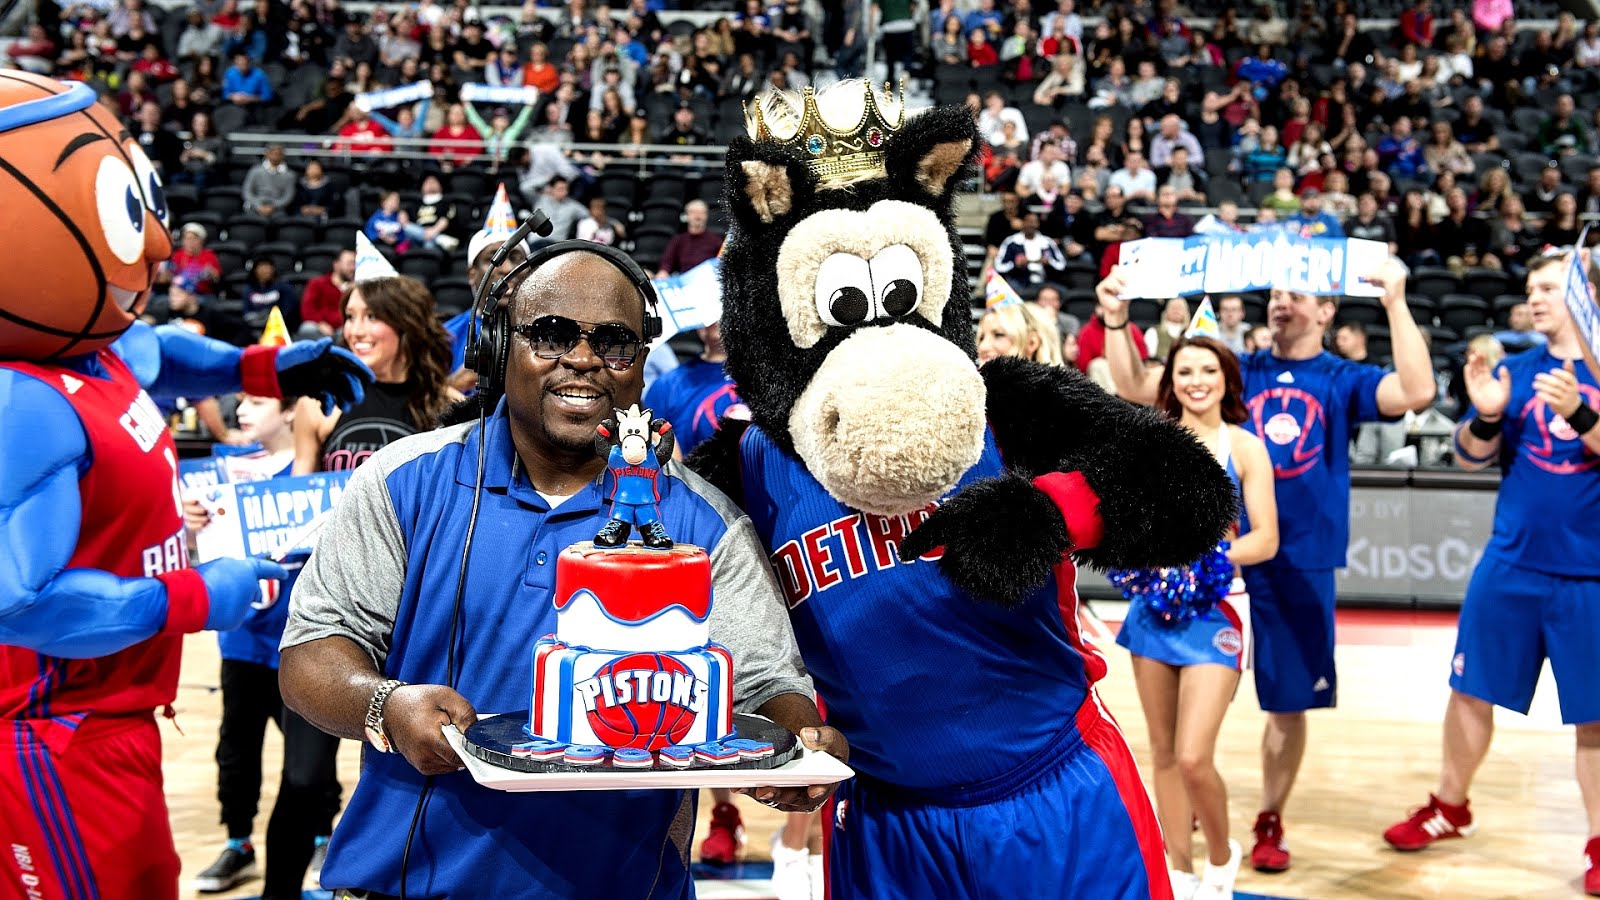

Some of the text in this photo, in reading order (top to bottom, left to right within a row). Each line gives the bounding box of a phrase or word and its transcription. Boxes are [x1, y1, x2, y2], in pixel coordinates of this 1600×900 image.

[615, 465, 657, 479] PISTONS
[243, 488, 324, 530] HAPPY
[573, 668, 710, 714] PISTONS
[11, 843, 35, 871] NBA
